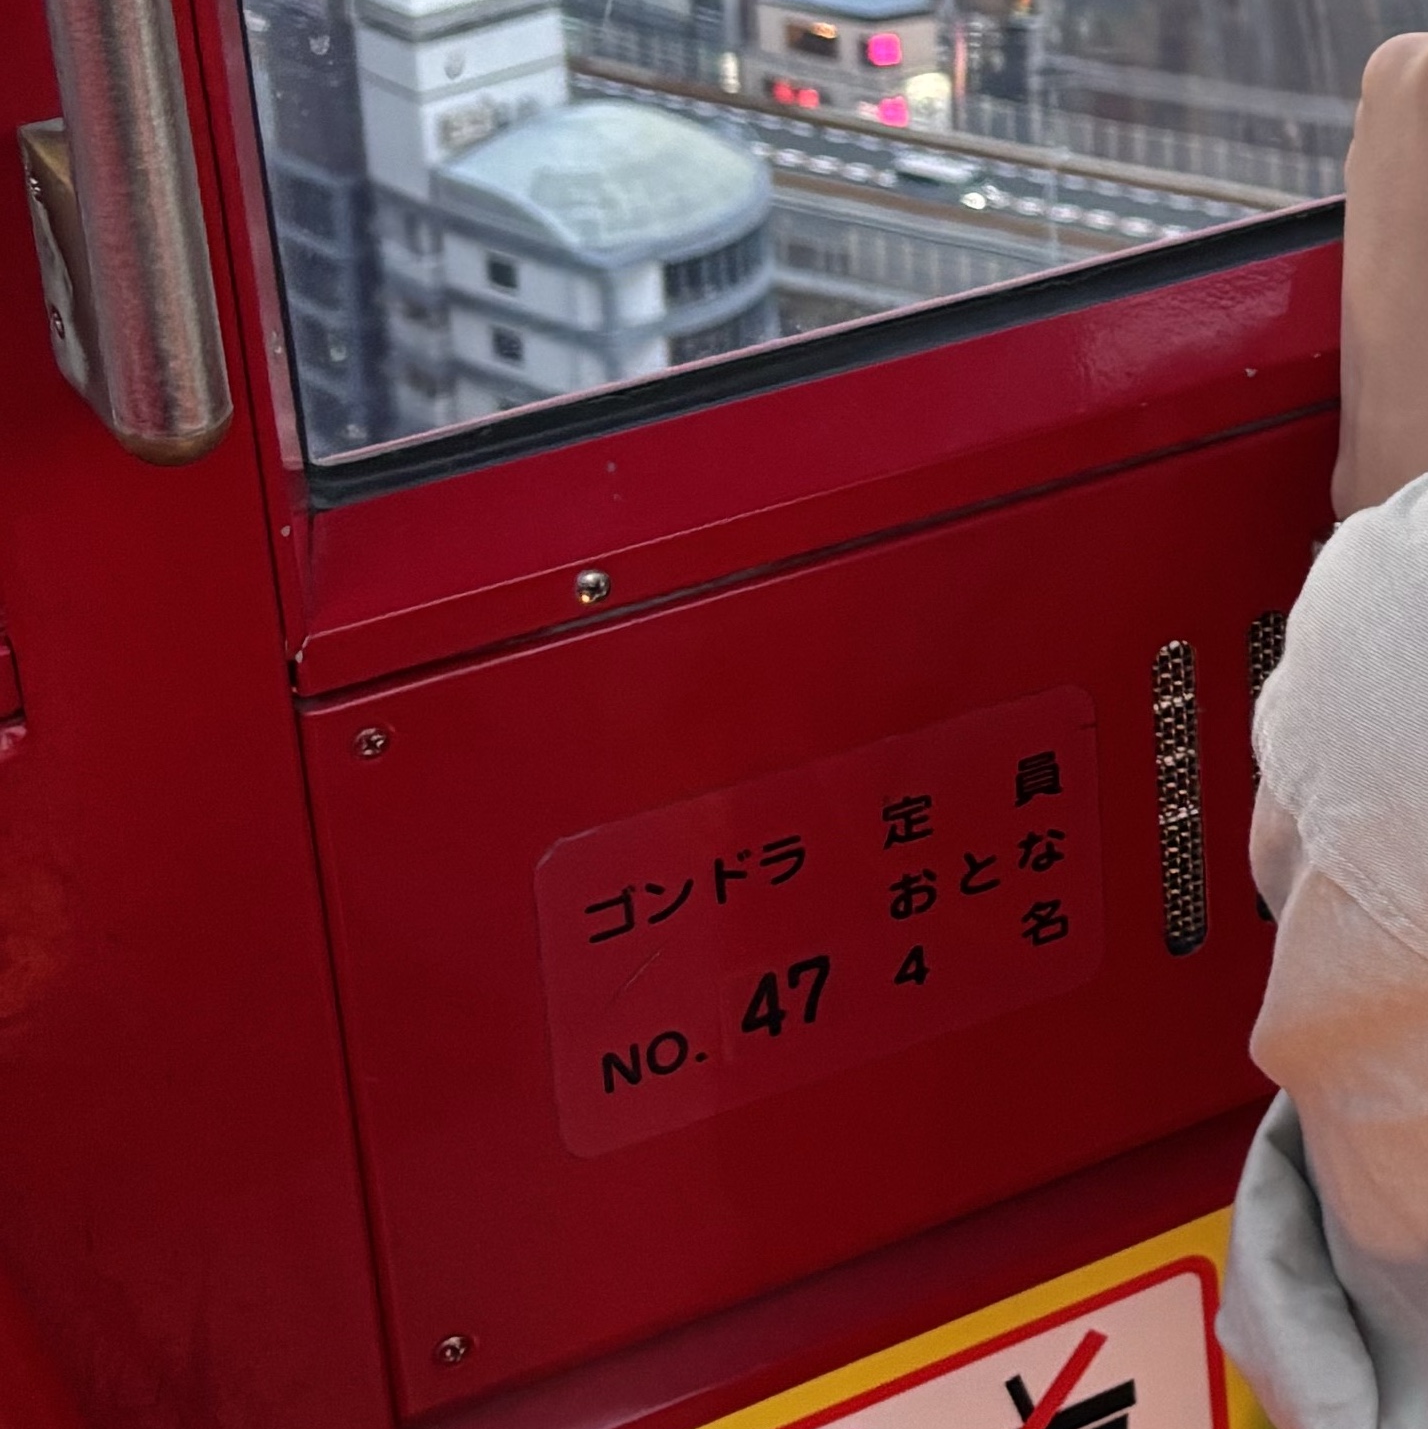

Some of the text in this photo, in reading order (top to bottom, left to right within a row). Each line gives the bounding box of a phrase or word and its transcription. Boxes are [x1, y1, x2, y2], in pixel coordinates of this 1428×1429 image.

[584, 834, 806, 944] ゴンドラ
[888, 828, 1066, 920] おとな
[601, 954, 831, 1094] NO. 47
